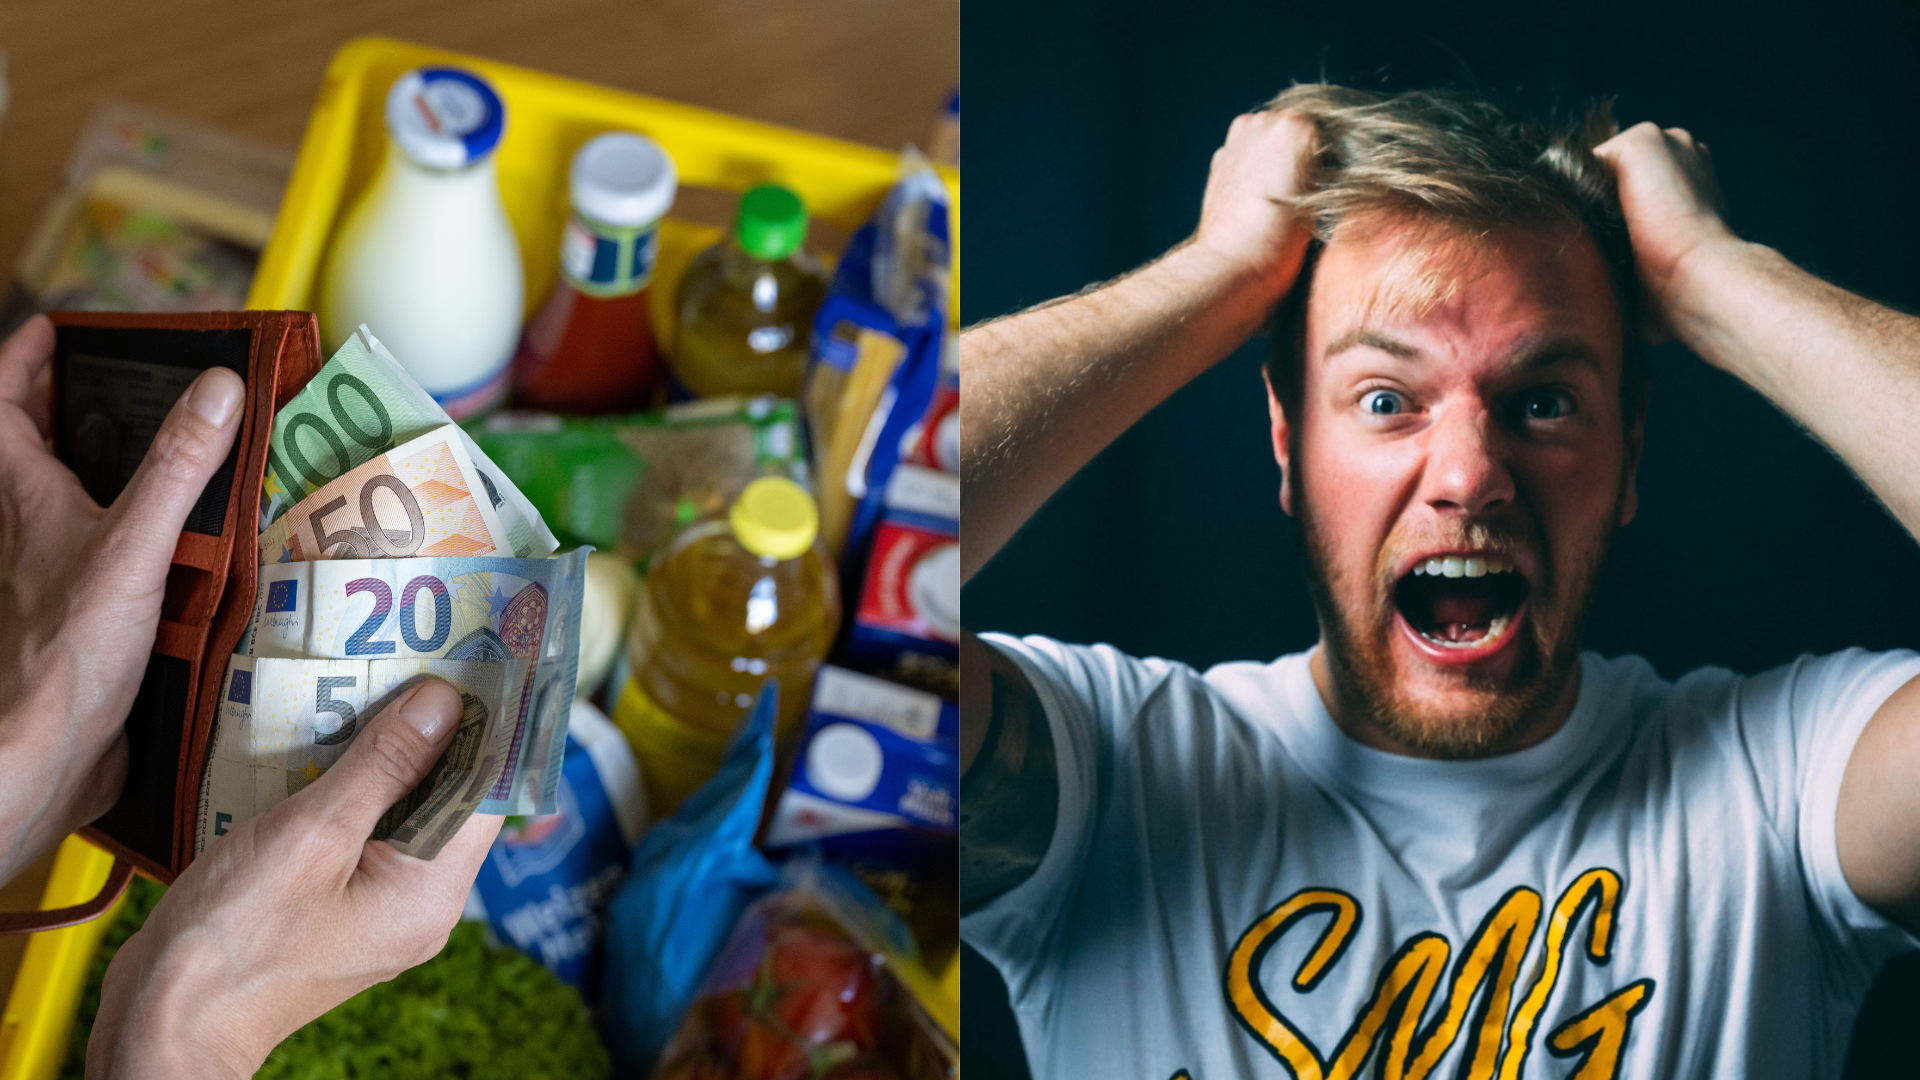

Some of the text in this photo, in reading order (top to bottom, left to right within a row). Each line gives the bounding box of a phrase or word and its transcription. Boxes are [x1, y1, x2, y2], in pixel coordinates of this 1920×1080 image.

[269, 373, 393, 503] 100
[309, 474, 426, 560] 50
[345, 575, 451, 655] 20
[315, 676, 356, 745] 5
